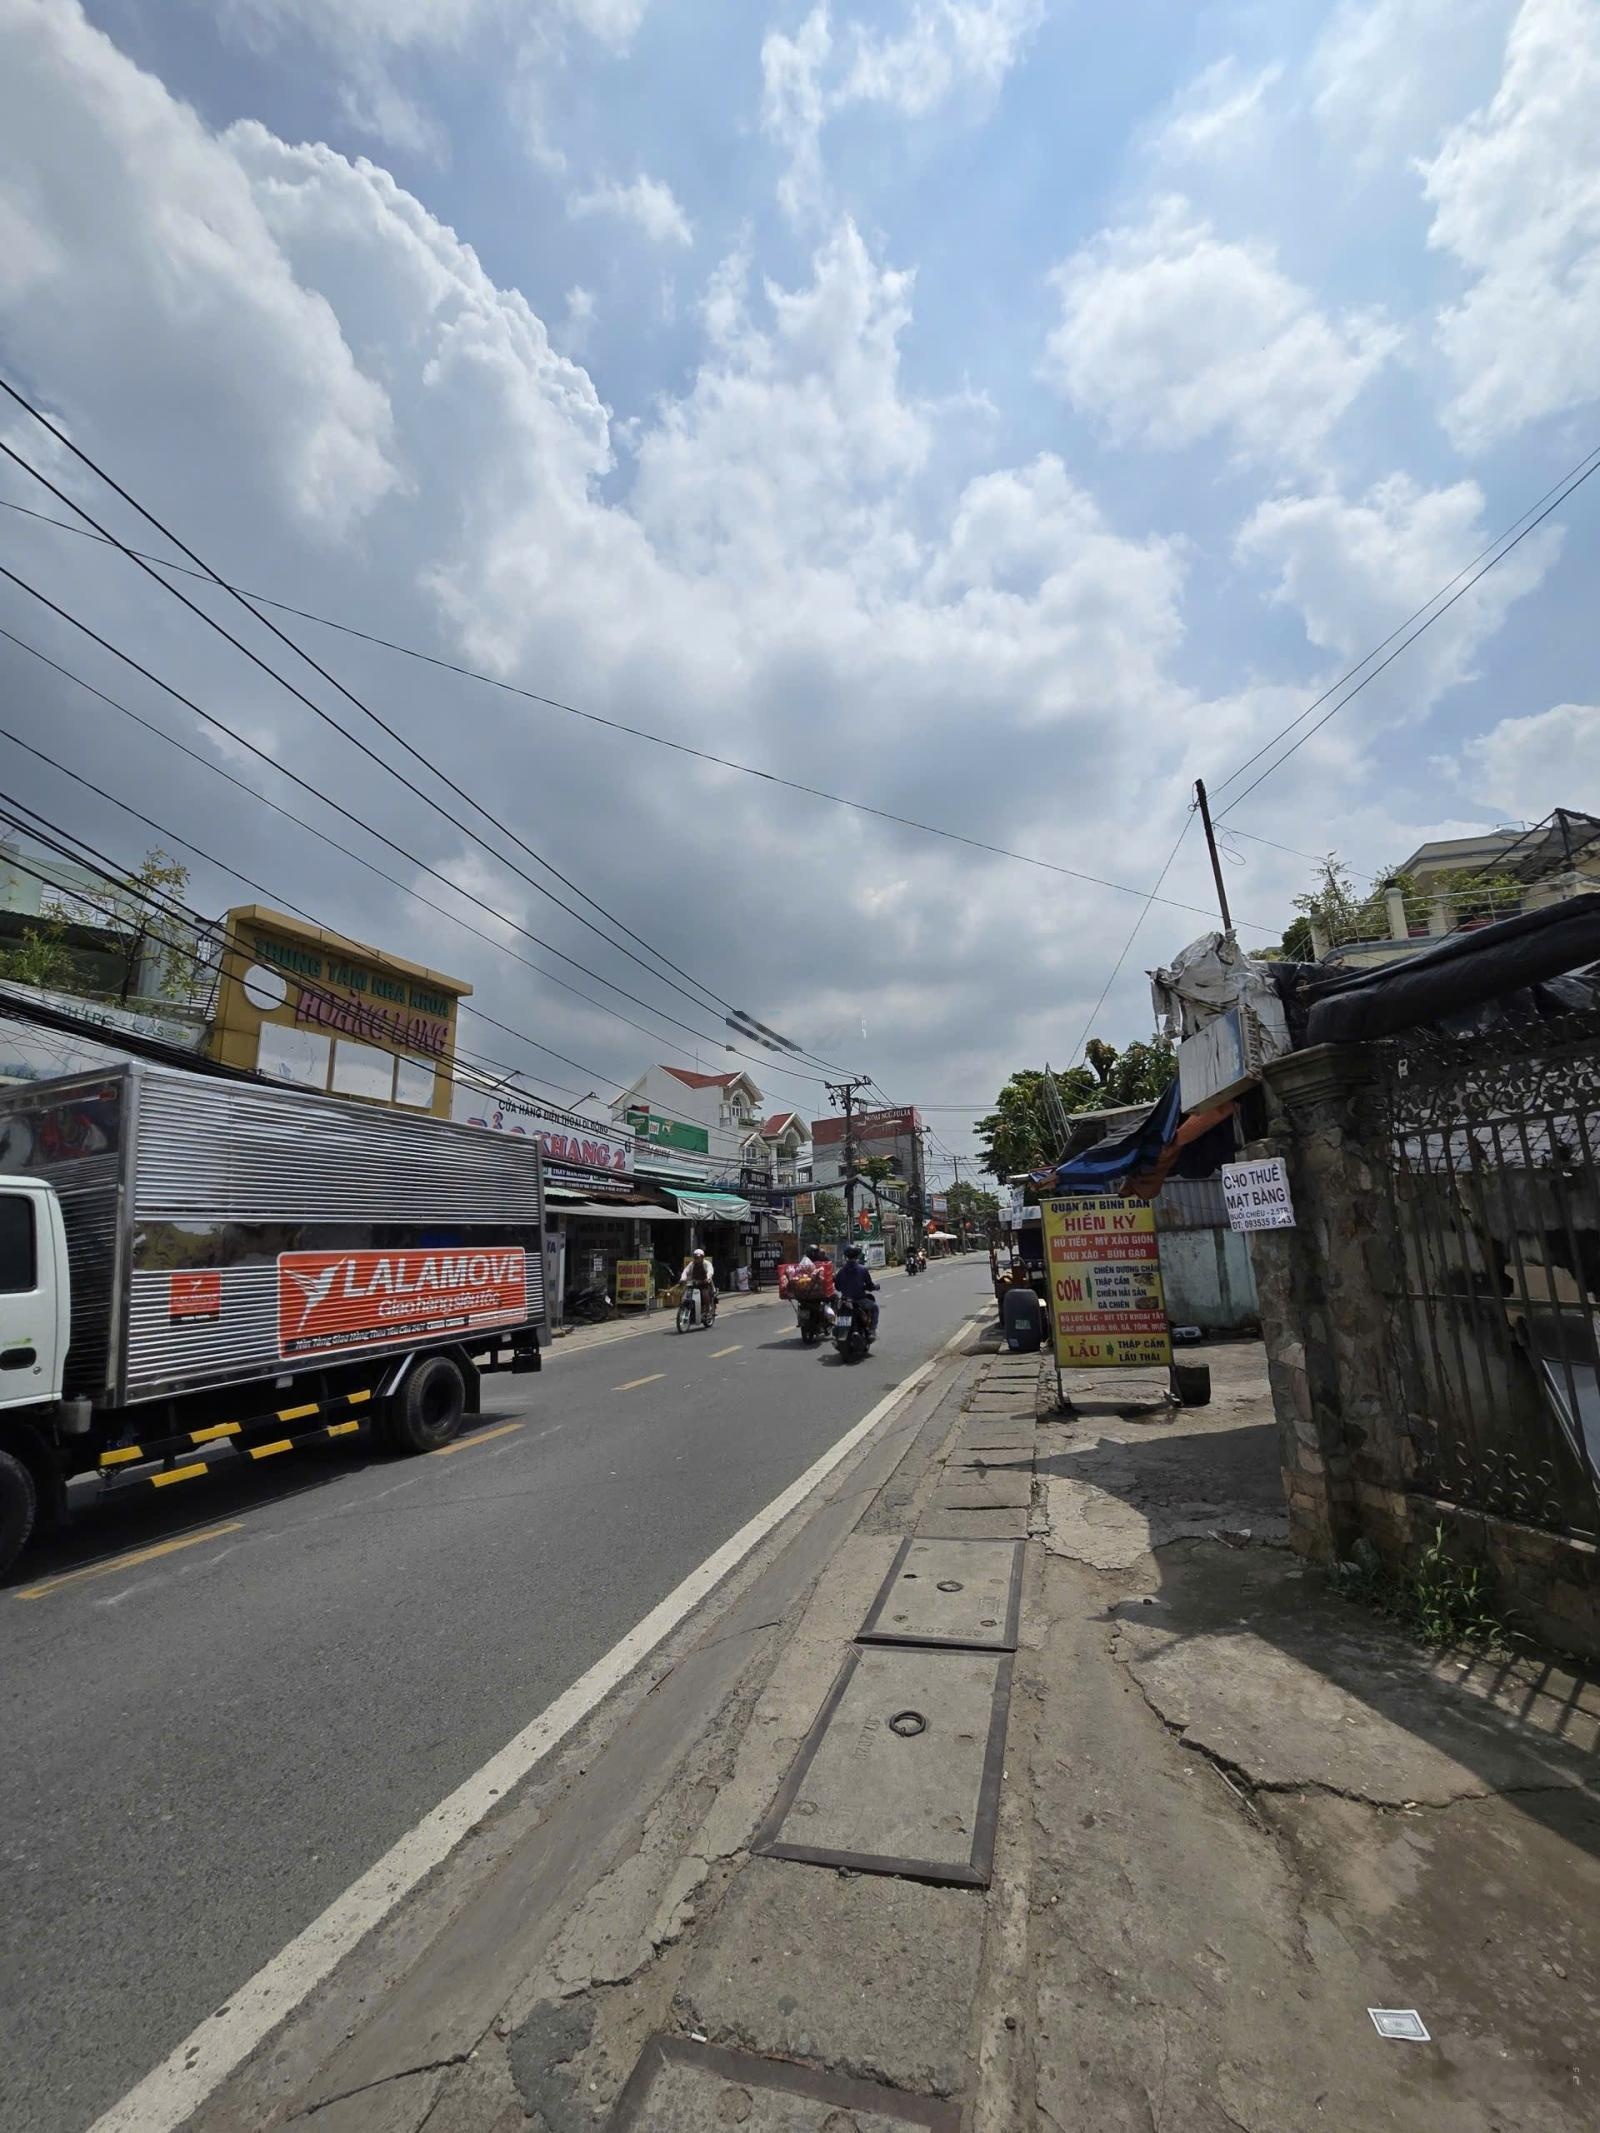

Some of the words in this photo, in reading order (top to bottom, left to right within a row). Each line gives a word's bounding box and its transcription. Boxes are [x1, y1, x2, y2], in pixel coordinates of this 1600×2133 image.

[371, 975, 405, 1004] NHA
[613, 1149, 626, 1170] 2
[1224, 1173, 1247, 1189] CHO
[1249, 1163, 1280, 1185] THUÊ
[342, 1253, 524, 1298] LALAMOVE
[1056, 1275, 1082, 1301] CƠM
